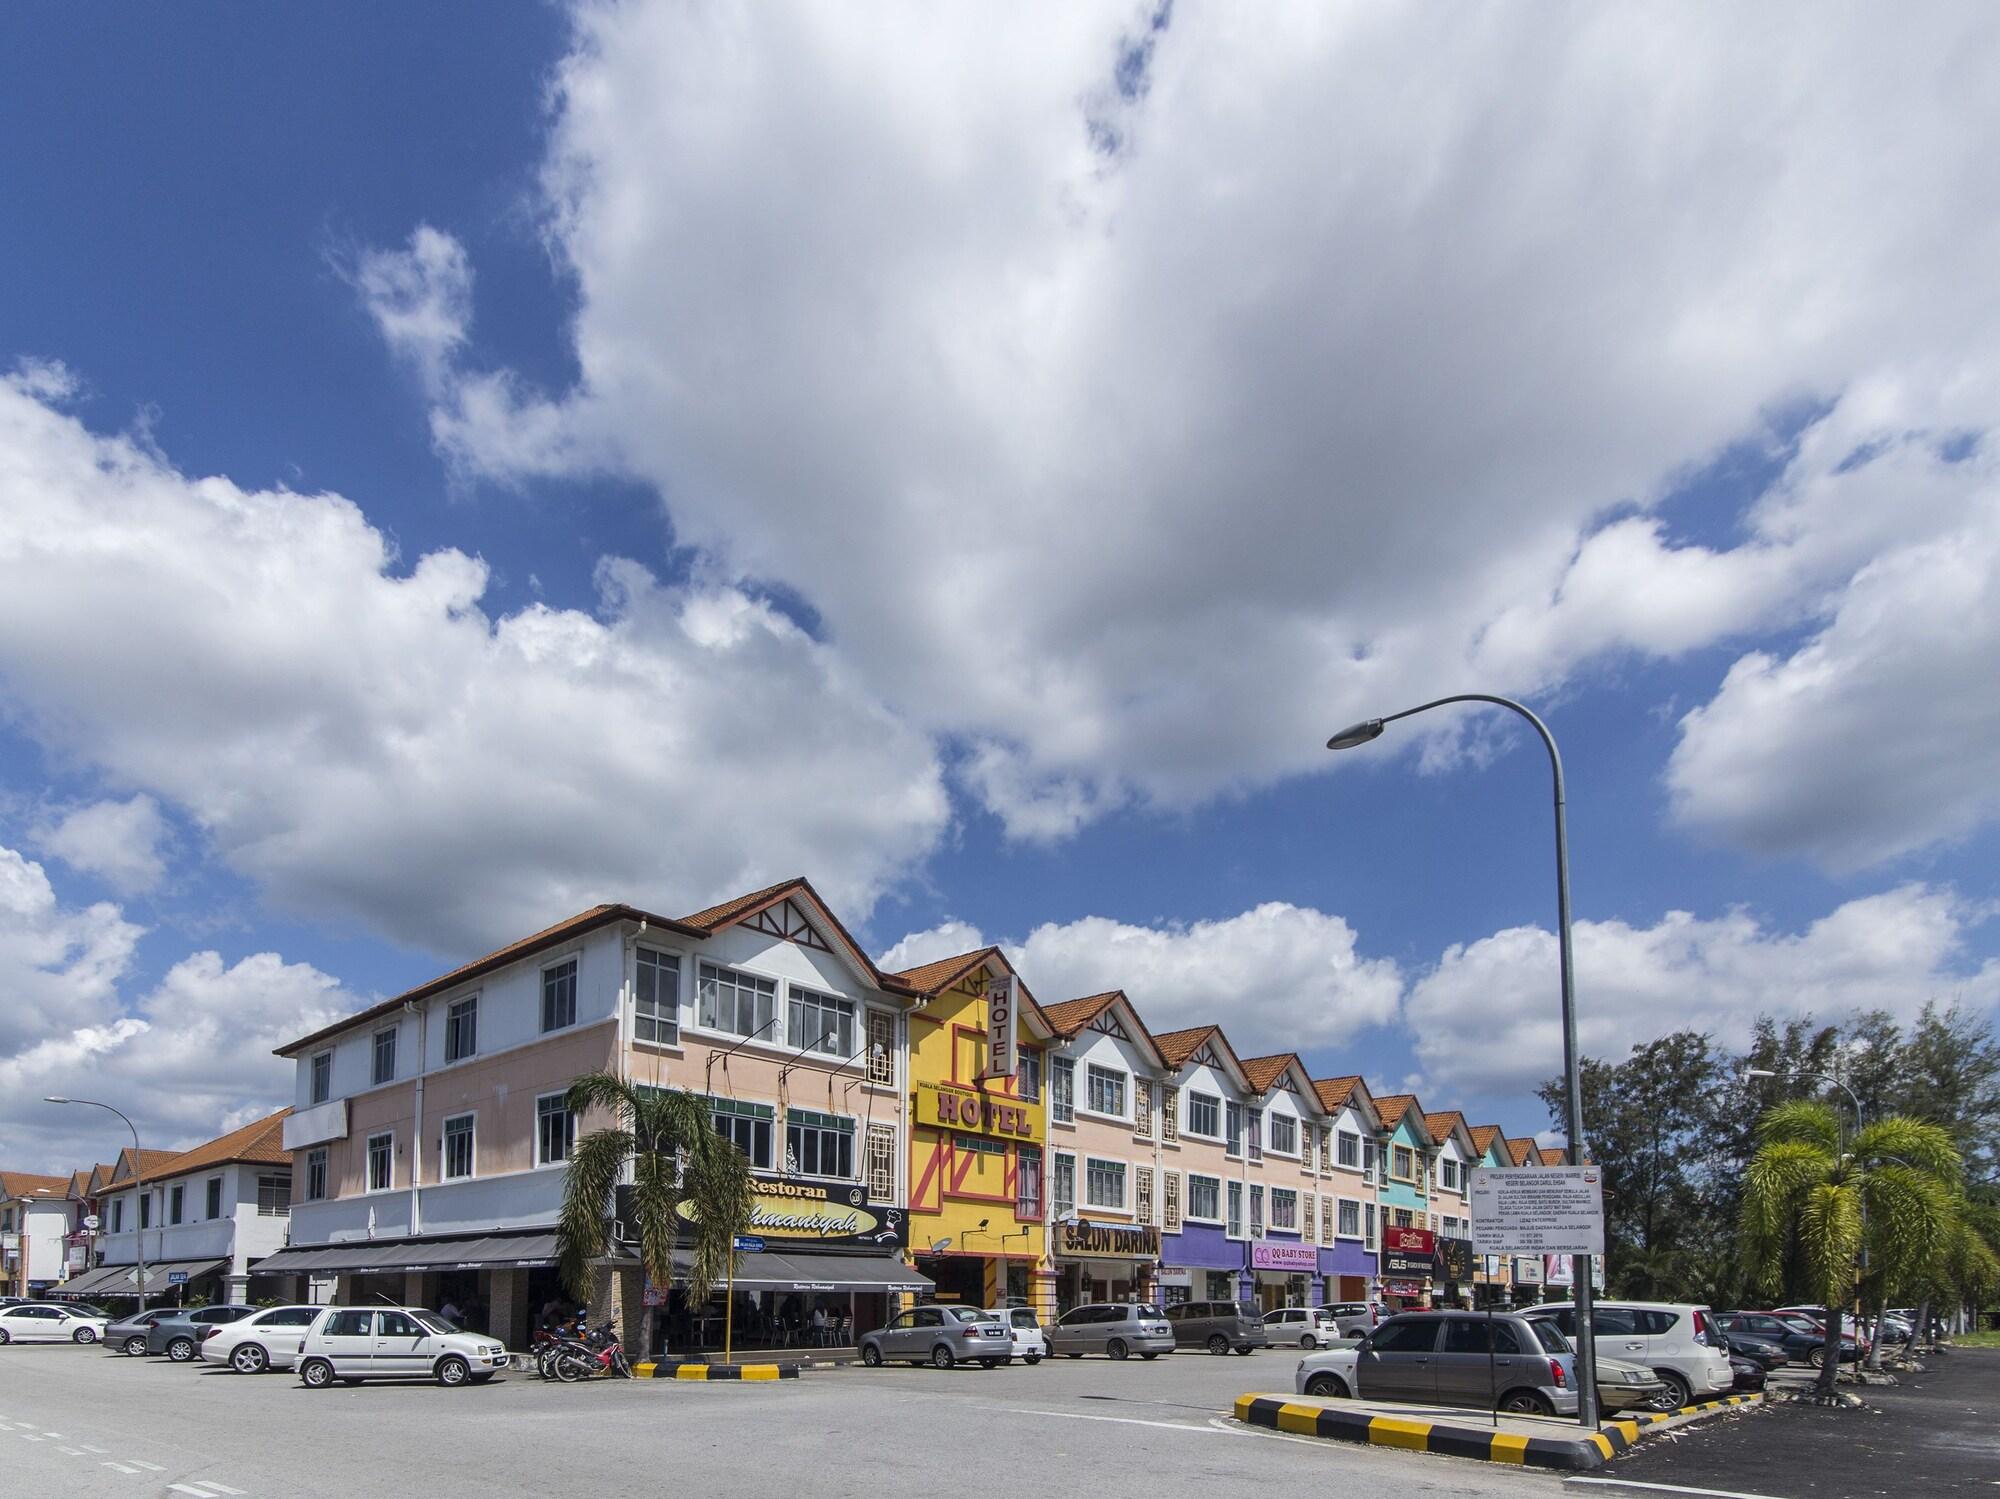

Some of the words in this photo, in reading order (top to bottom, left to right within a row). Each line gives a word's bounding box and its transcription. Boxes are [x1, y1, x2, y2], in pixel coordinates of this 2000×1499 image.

[992, 991, 1008, 1073] HOTEL
[938, 1092, 1032, 1137] HOTEL
[749, 1178, 827, 1199] Restoran
[750, 1204, 857, 1236] hmaniyah
[1114, 1229, 1158, 1255] DARINA
[1272, 1248, 1281, 1258] QQ
[1282, 1249, 1297, 1258] BABY
[1298, 1250, 1315, 1259] STORE
[1388, 1259, 1407, 1270] ASUS
